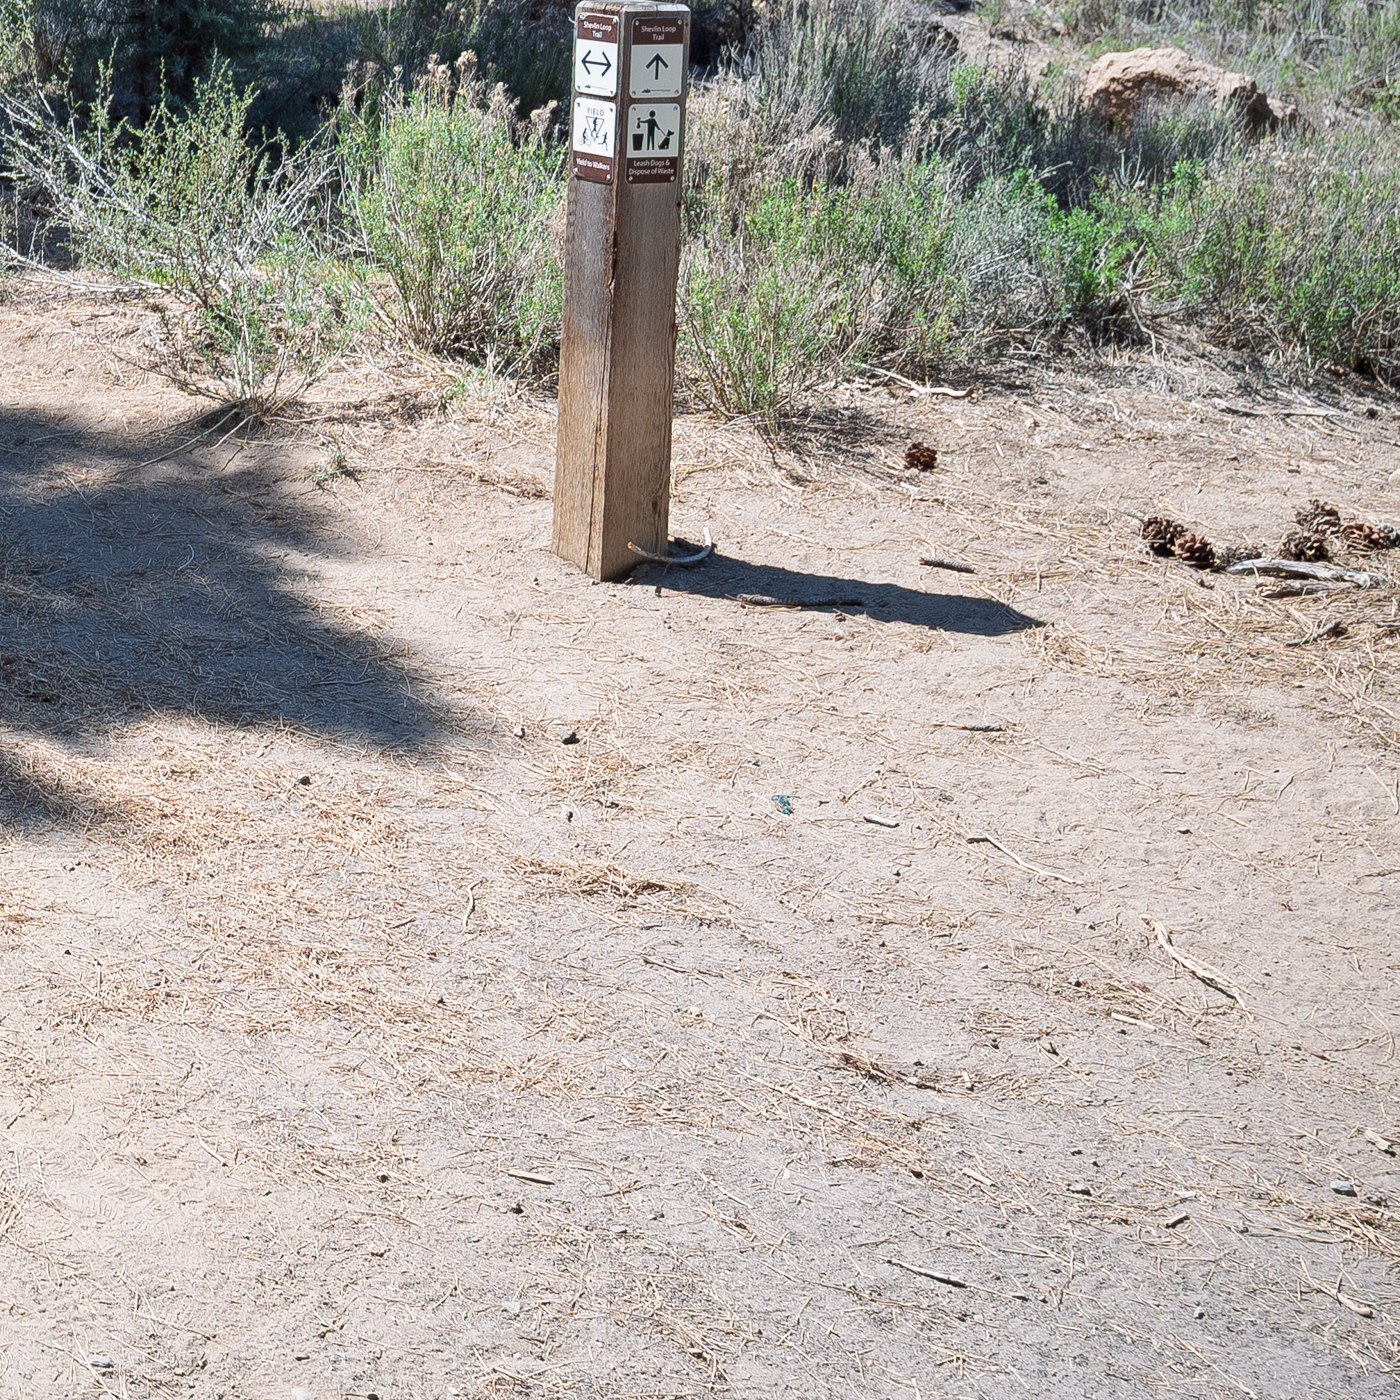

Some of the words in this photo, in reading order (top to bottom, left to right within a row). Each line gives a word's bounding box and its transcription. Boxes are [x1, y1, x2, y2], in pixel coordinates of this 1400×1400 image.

[584, 21, 600, 29] Shevlin
[600, 23, 612, 32] Loop
[587, 107, 604, 116] YIELD
